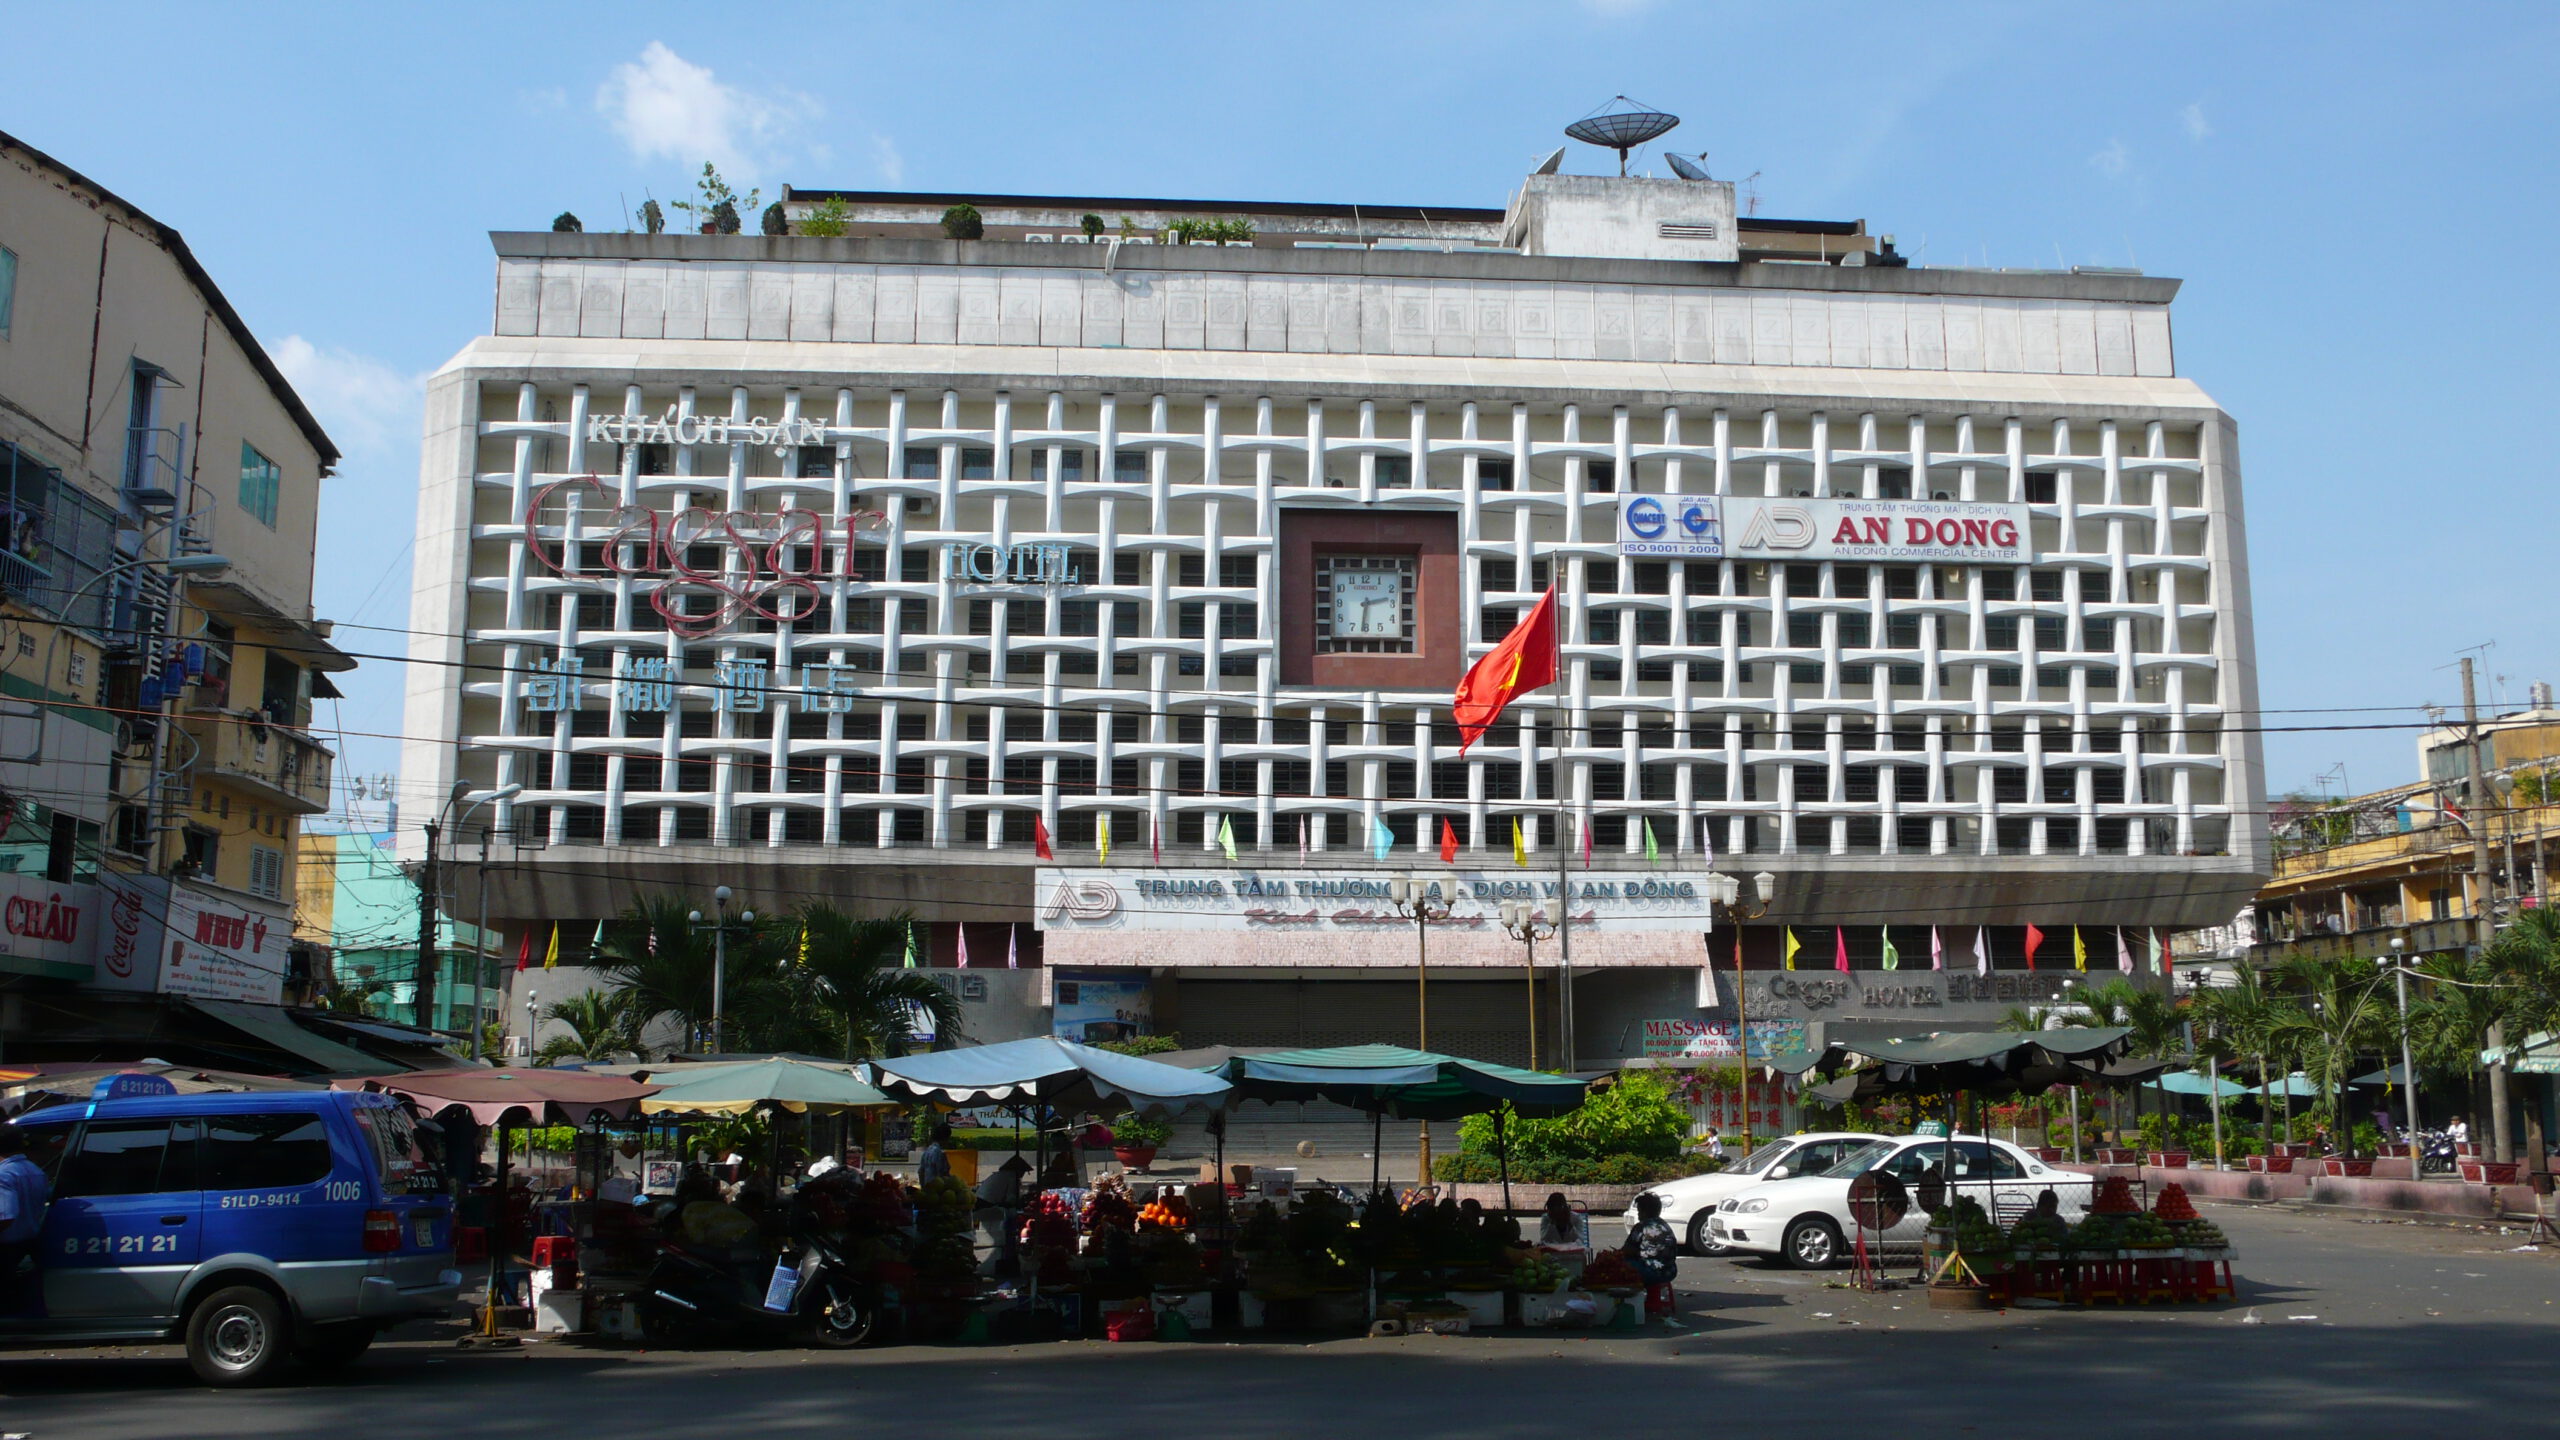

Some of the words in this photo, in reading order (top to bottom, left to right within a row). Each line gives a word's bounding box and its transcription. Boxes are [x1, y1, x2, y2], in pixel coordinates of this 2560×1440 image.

[588, 403, 732, 445] KHÁCH
[1839, 504, 1873, 512] TRUNG
[1832, 516, 1891, 545] AN
[1904, 517, 2019, 548] DONG
[1624, 544, 1647, 552] ISO
[1650, 545, 1678, 553] 9001
[1688, 545, 1719, 554] 2000
[1834, 547, 1851, 555] AN
[1853, 547, 1887, 556] DONG
[1891, 548, 1968, 557] COMMERCIAL
[1971, 549, 2019, 559] CENTER
[943, 543, 1079, 585] HOTEL
[1135, 879, 1224, 897] TRUNG
[1232, 876, 1288, 897] TÂM
[1473, 880, 1532, 903] DỊCH
[1582, 881, 1615, 898] AN
[1623, 876, 1695, 898] ĐÔNG
[5, 892, 80, 944] CHÂU
[104, 886, 143, 978] Coca-Cola
[194, 910, 250, 950] NHƯ
[252, 915, 268, 954] Ý
[1645, 1021, 1733, 1037] MASSAGE
[121, 1079, 128, 1092] 8
[129, 1080, 141, 1094] 21
[143, 1081, 154, 1094] 21
[155, 1082, 166, 1095] 21
[221, 1192, 301, 1209] 51LD-9414
[324, 1180, 361, 1202] 1006
[65, 1237, 78, 1254] 8
[87, 1237, 111, 1254] 21
[120, 1235, 144, 1253] 21
[152, 1234, 176, 1252] 21
